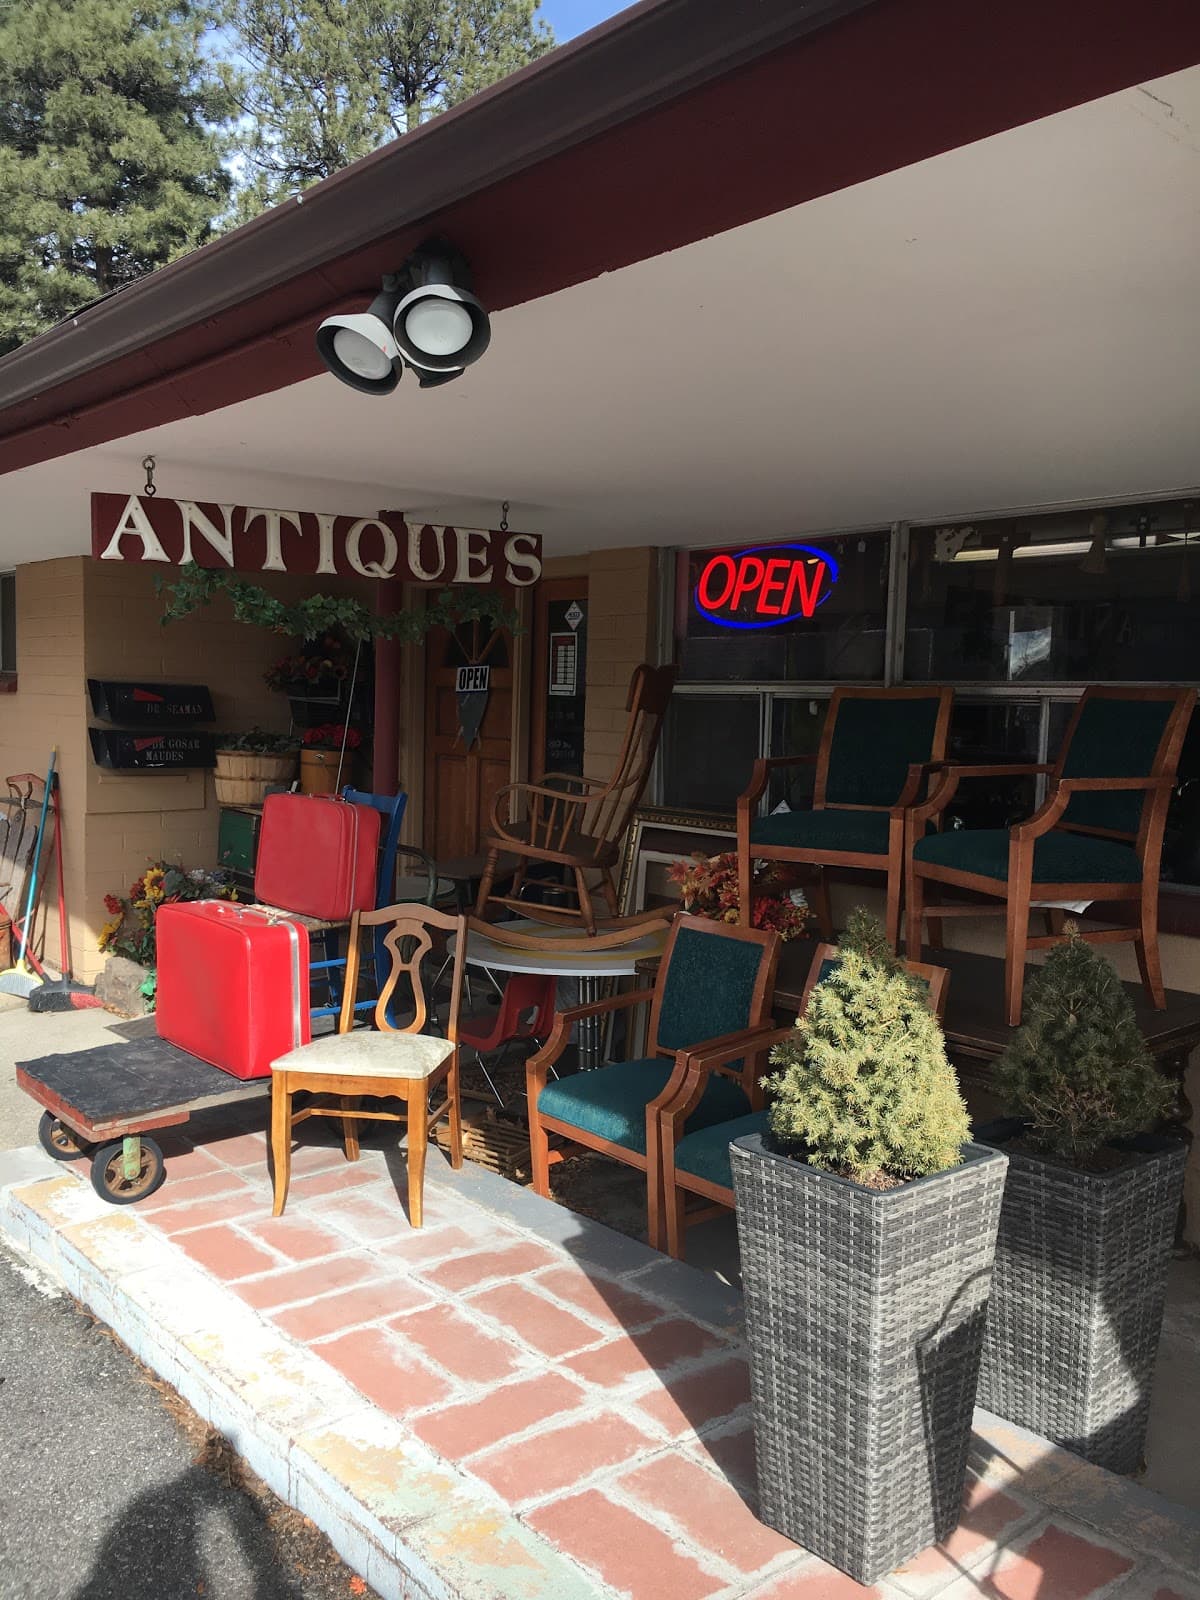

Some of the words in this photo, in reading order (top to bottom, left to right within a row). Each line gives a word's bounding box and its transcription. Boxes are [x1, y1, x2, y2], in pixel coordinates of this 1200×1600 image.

[100, 494, 542, 587] ANTIQUES
[698, 554, 826, 617] OPEN
[458, 667, 488, 690] OPEN
[145, 751, 184, 761] MAUDES
